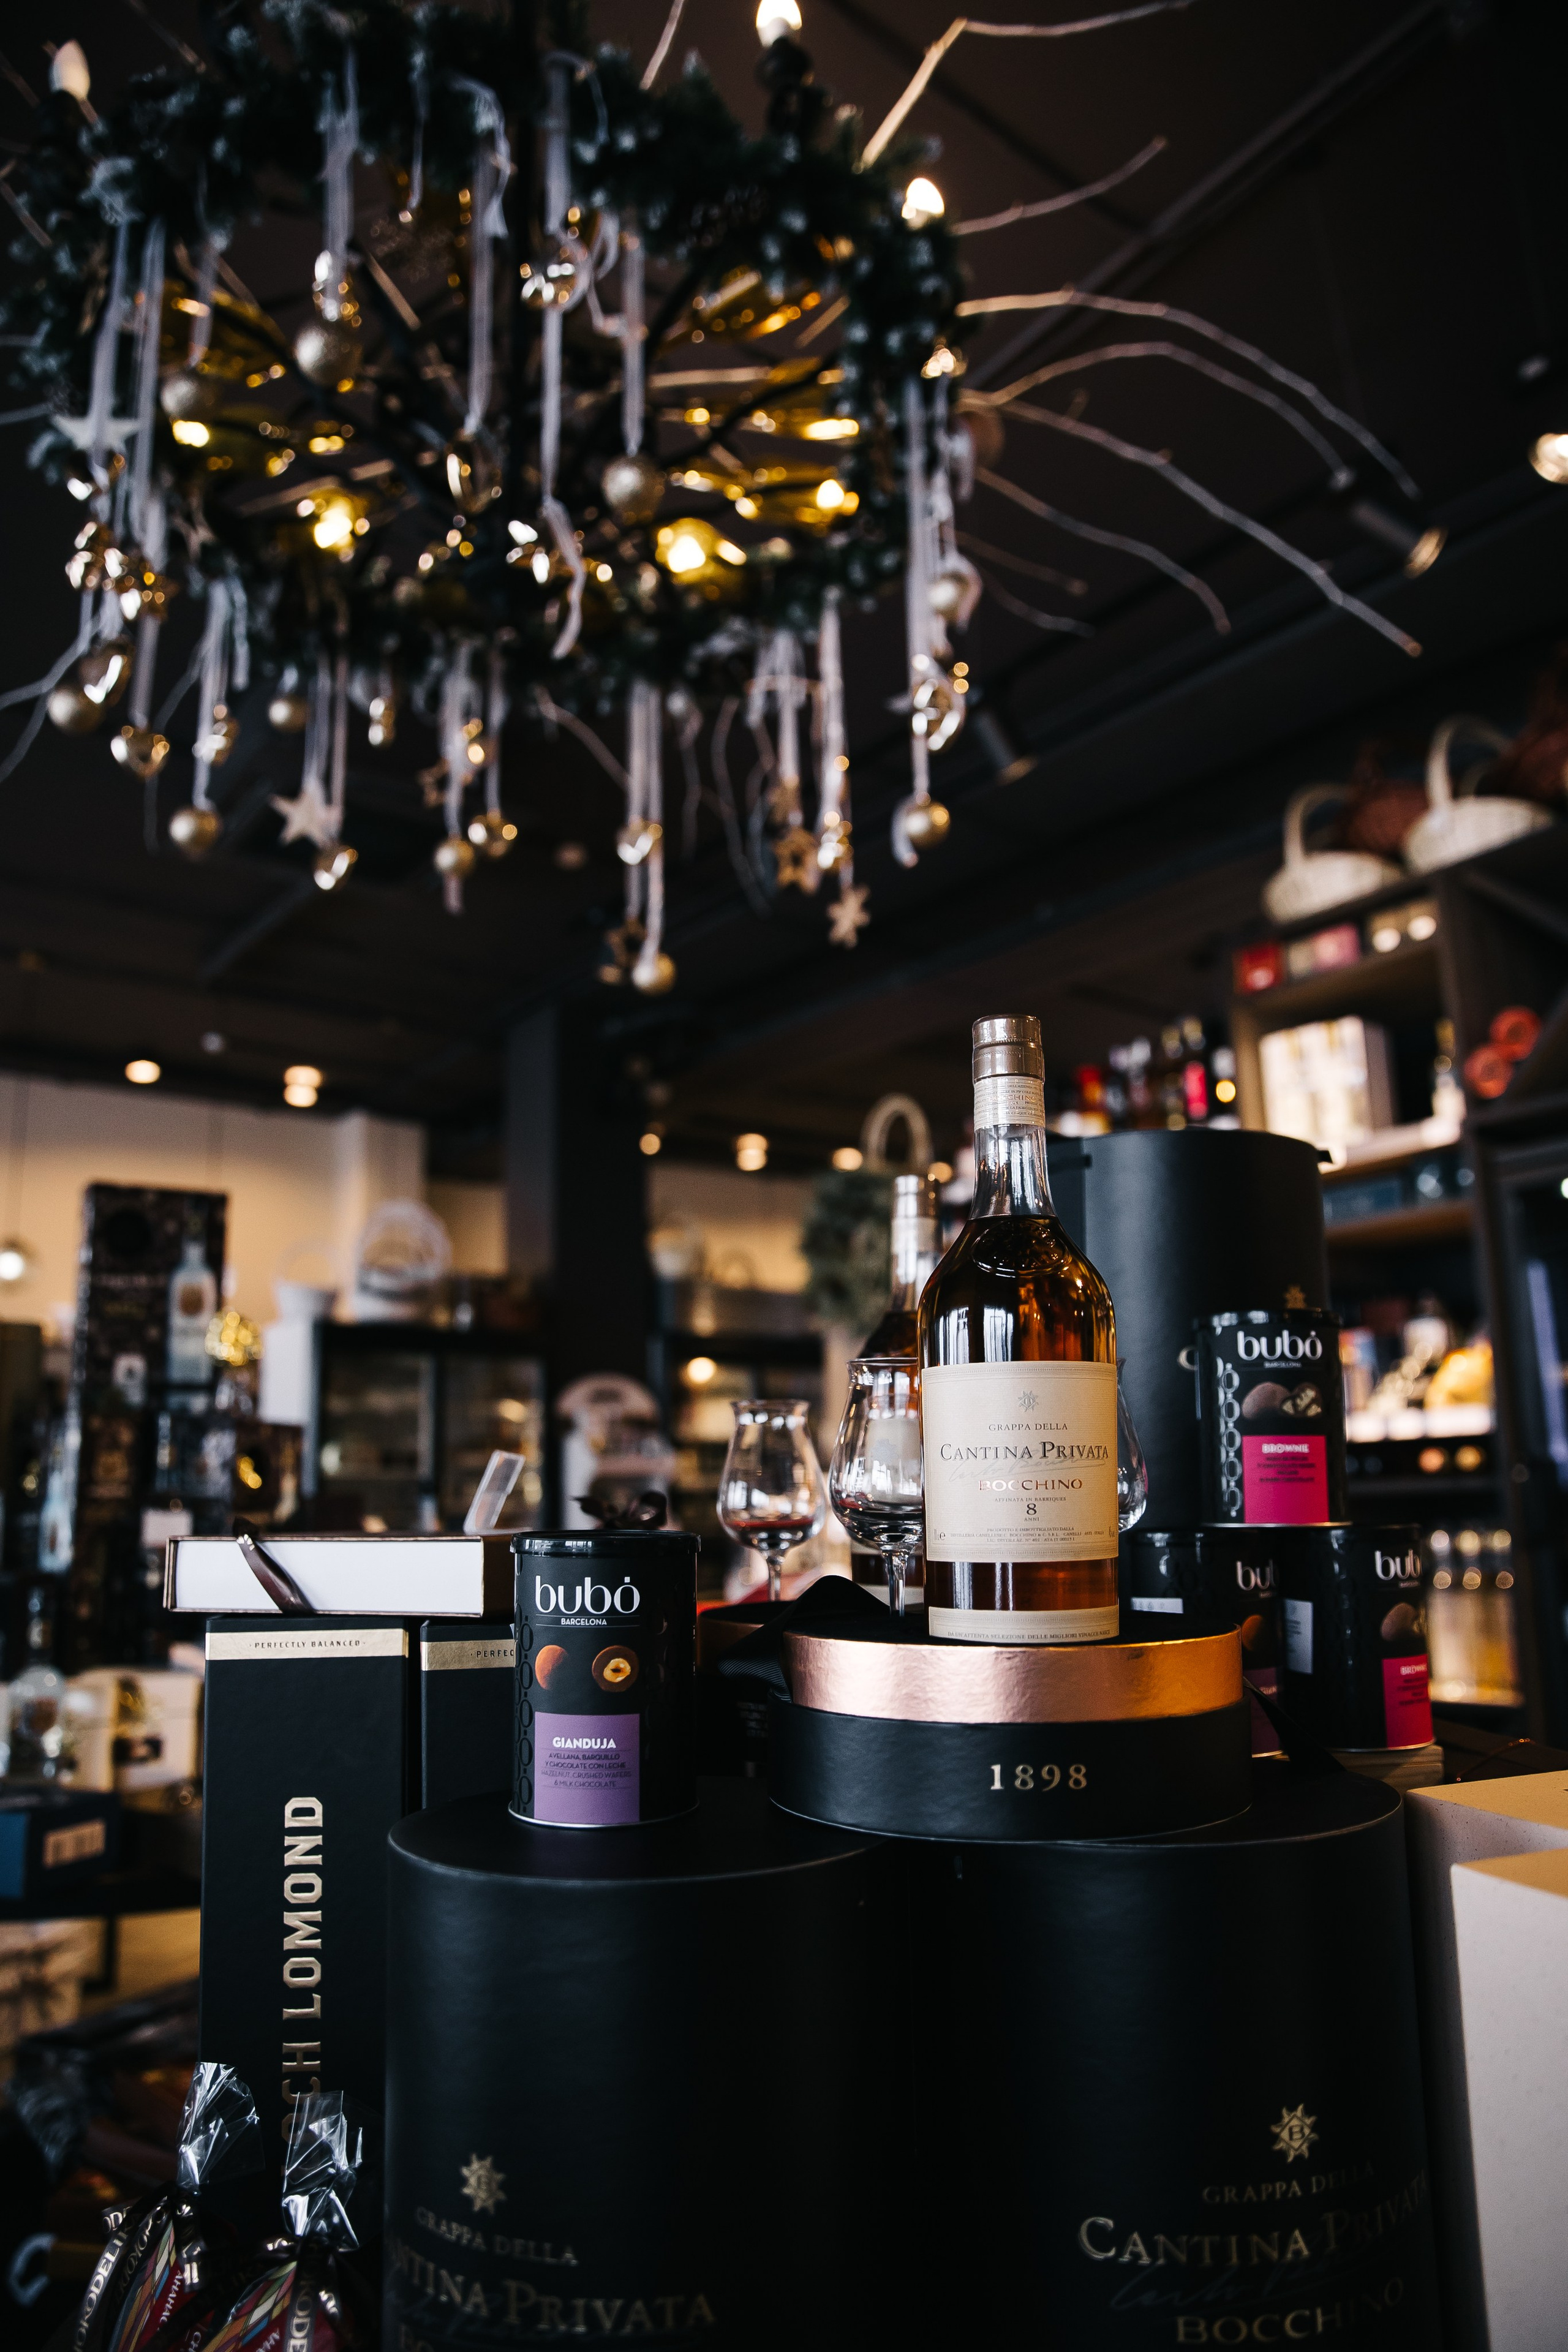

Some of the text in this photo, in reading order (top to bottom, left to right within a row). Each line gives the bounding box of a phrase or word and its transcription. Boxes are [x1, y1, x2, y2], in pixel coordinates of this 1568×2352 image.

[989, 1423, 1031, 1431] GRAPPA
[940, 1443, 1032, 1461] CANTINA
[1040, 1441, 1109, 1460] PRIVATA
[979, 1479, 1083, 1491] BOCCHINO
[1027, 1503, 1037, 1515] 8
[552, 1736, 616, 1749] GIANDUJA
[990, 1764, 1087, 1792] 1898
[283, 1796, 323, 2021] LOMOND
[1202, 2179, 1303, 2205] GRAPPA
[414, 2206, 580, 2266] GRAPPA DELLA
[1077, 2216, 1311, 2267] CANTINA
[502, 2277, 716, 2334] PRIVATA
[1176, 2277, 1404, 2345] BOCCHINO
